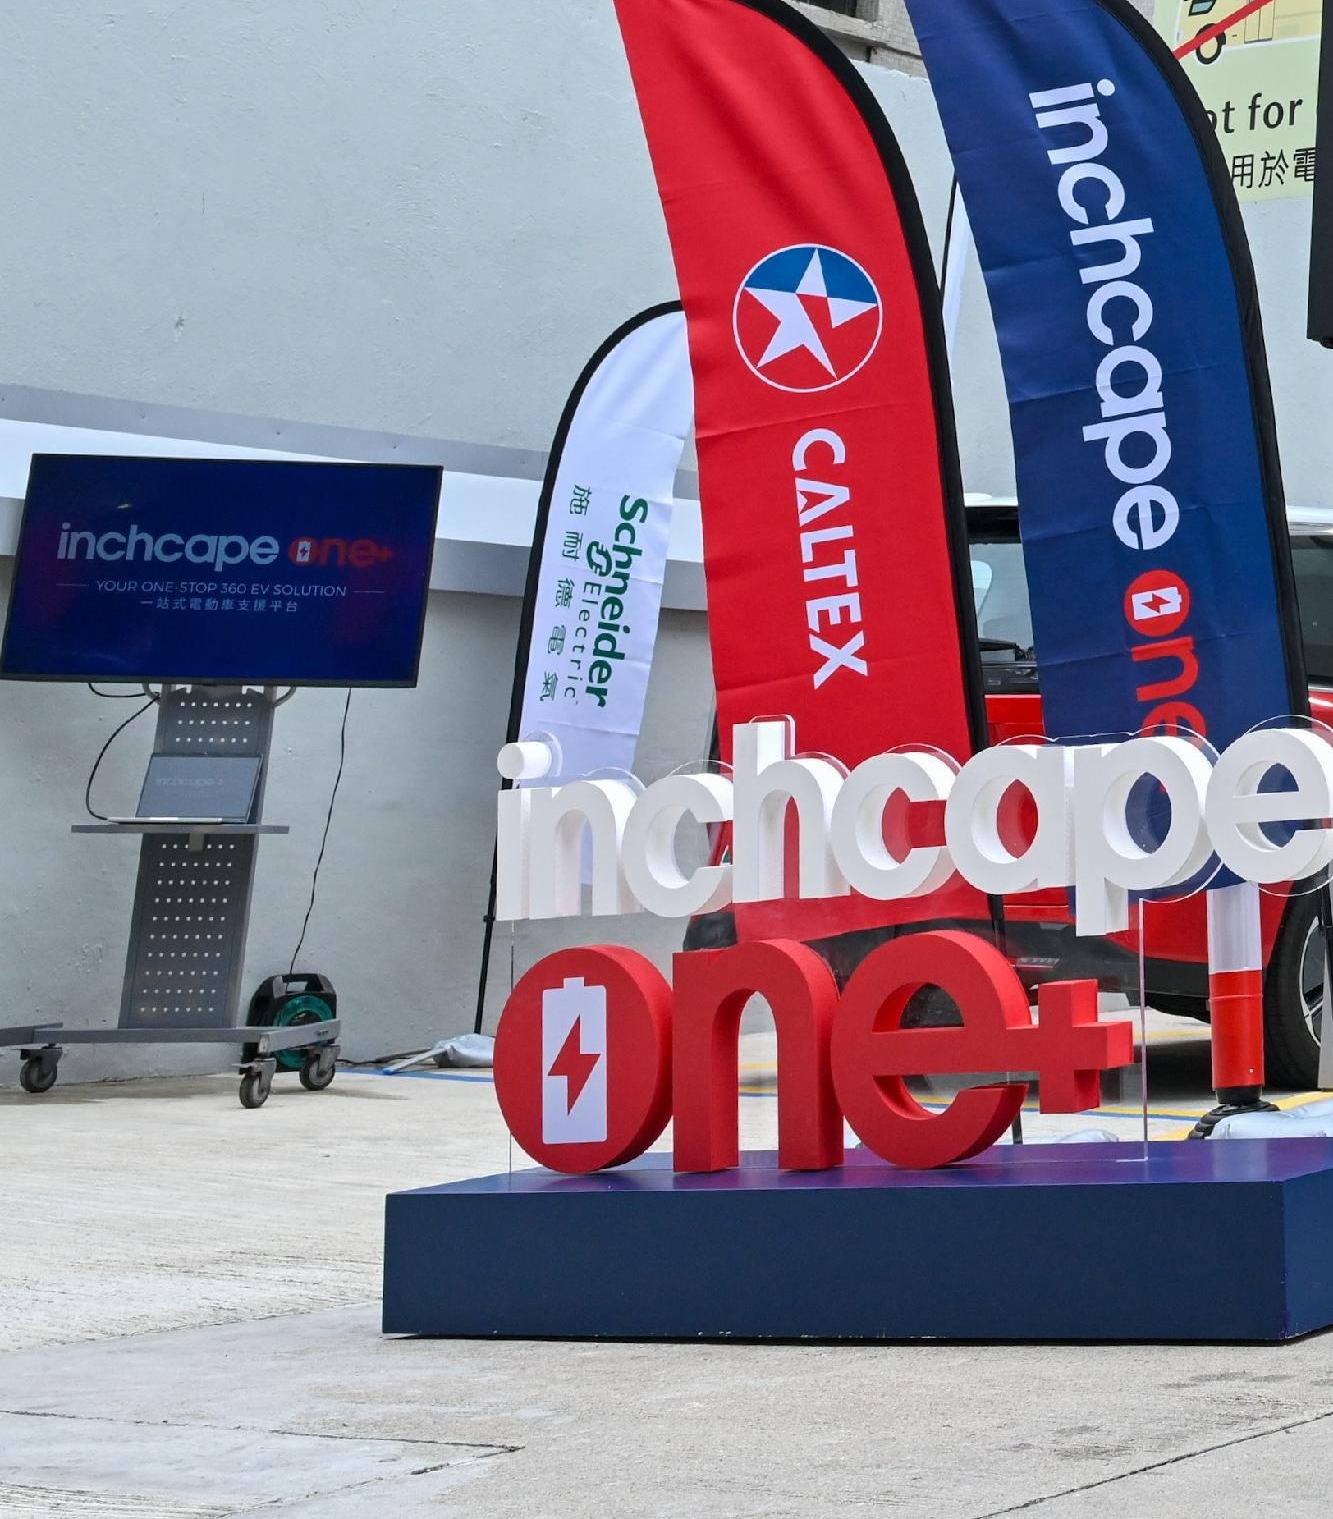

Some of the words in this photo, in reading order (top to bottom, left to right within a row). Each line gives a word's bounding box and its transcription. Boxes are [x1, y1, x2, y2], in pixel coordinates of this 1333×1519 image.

[1248, 92, 1303, 131] for
[1028, 78, 1181, 552] inchcape
[56, 522, 280, 572] inchcape
[96, 580, 138, 592] YOUR
[141, 581, 218, 594] ONE-STOP
[220, 583, 247, 595] 360
[250, 584, 270, 596] EV
[273, 585, 347, 597] SOLUTION
[140, 597, 299, 613] 一站式電動車支援平台
[538, 484, 593, 703] 施耐德電氣
[584, 495, 650, 709] Schneider
[792, 428, 869, 690] CALTEX
[564, 581, 602, 701] Electric
